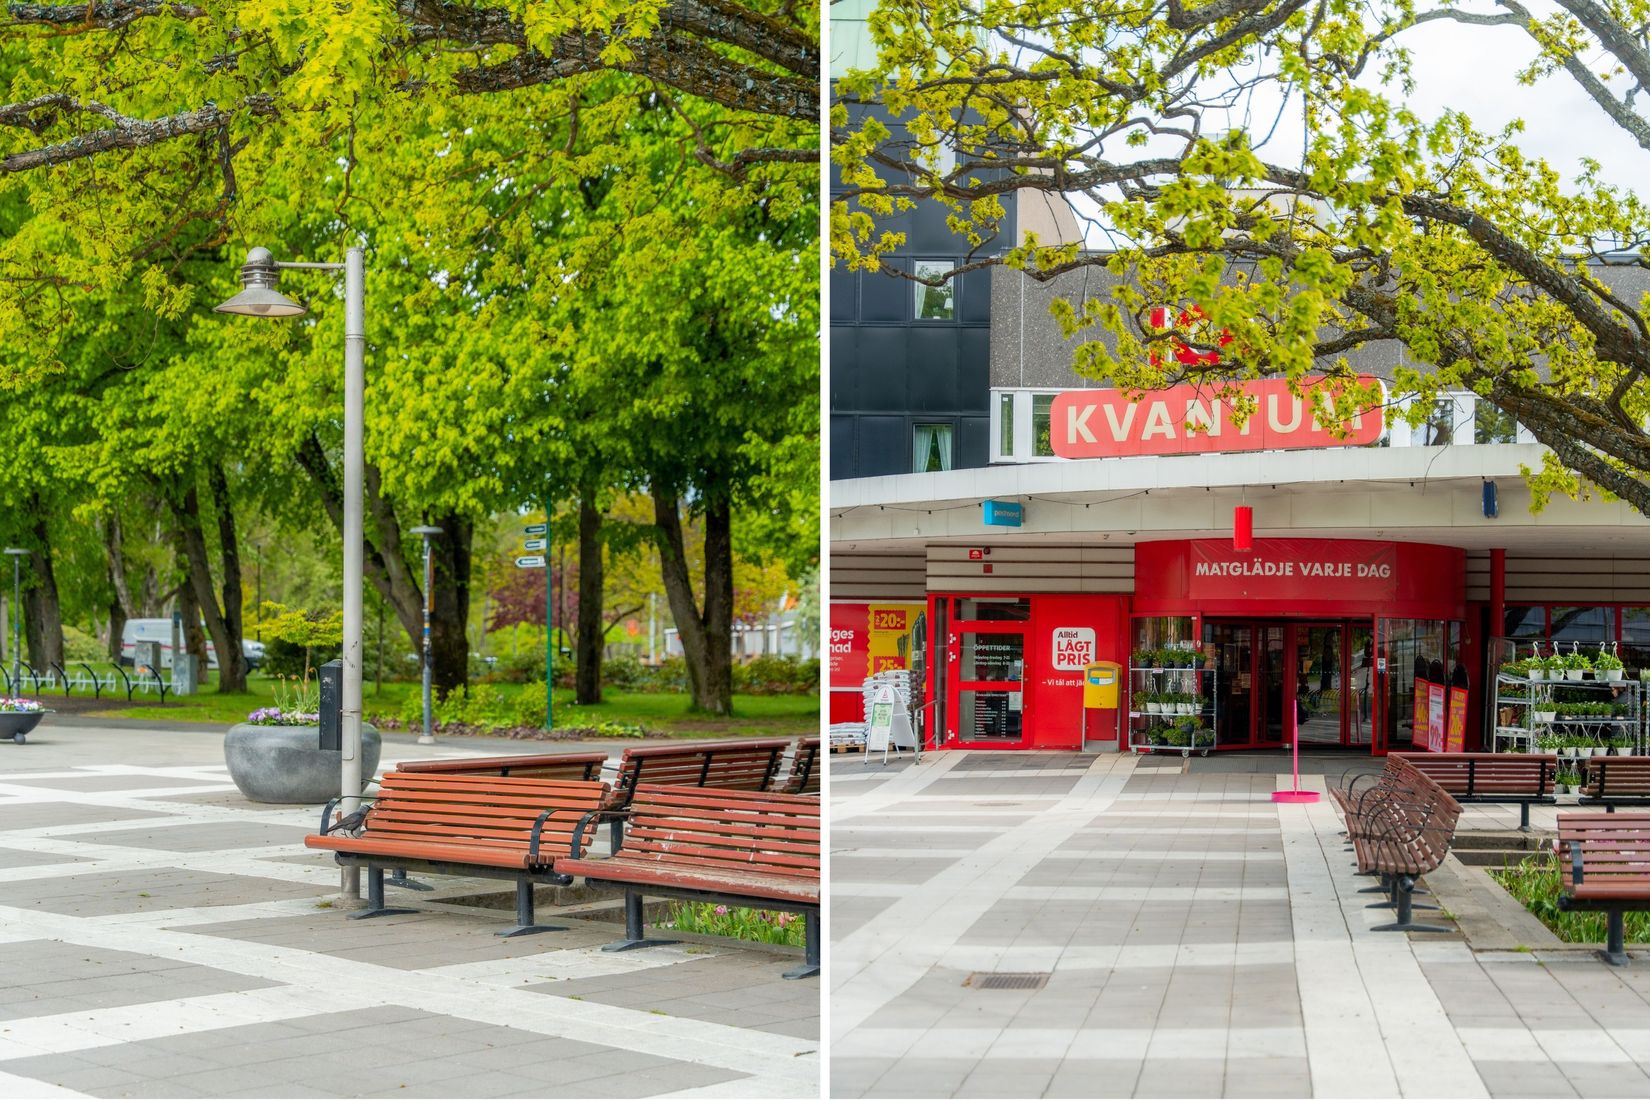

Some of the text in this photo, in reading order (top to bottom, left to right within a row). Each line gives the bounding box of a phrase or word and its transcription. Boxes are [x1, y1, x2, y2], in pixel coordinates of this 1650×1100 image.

[1196, 558, 1391, 578] MATGLÄDJE VARJE DAG
[1057, 631, 1078, 639] Alltid
[1057, 639, 1091, 652] LÅGT
[1057, 653, 1090, 666] PRIS
